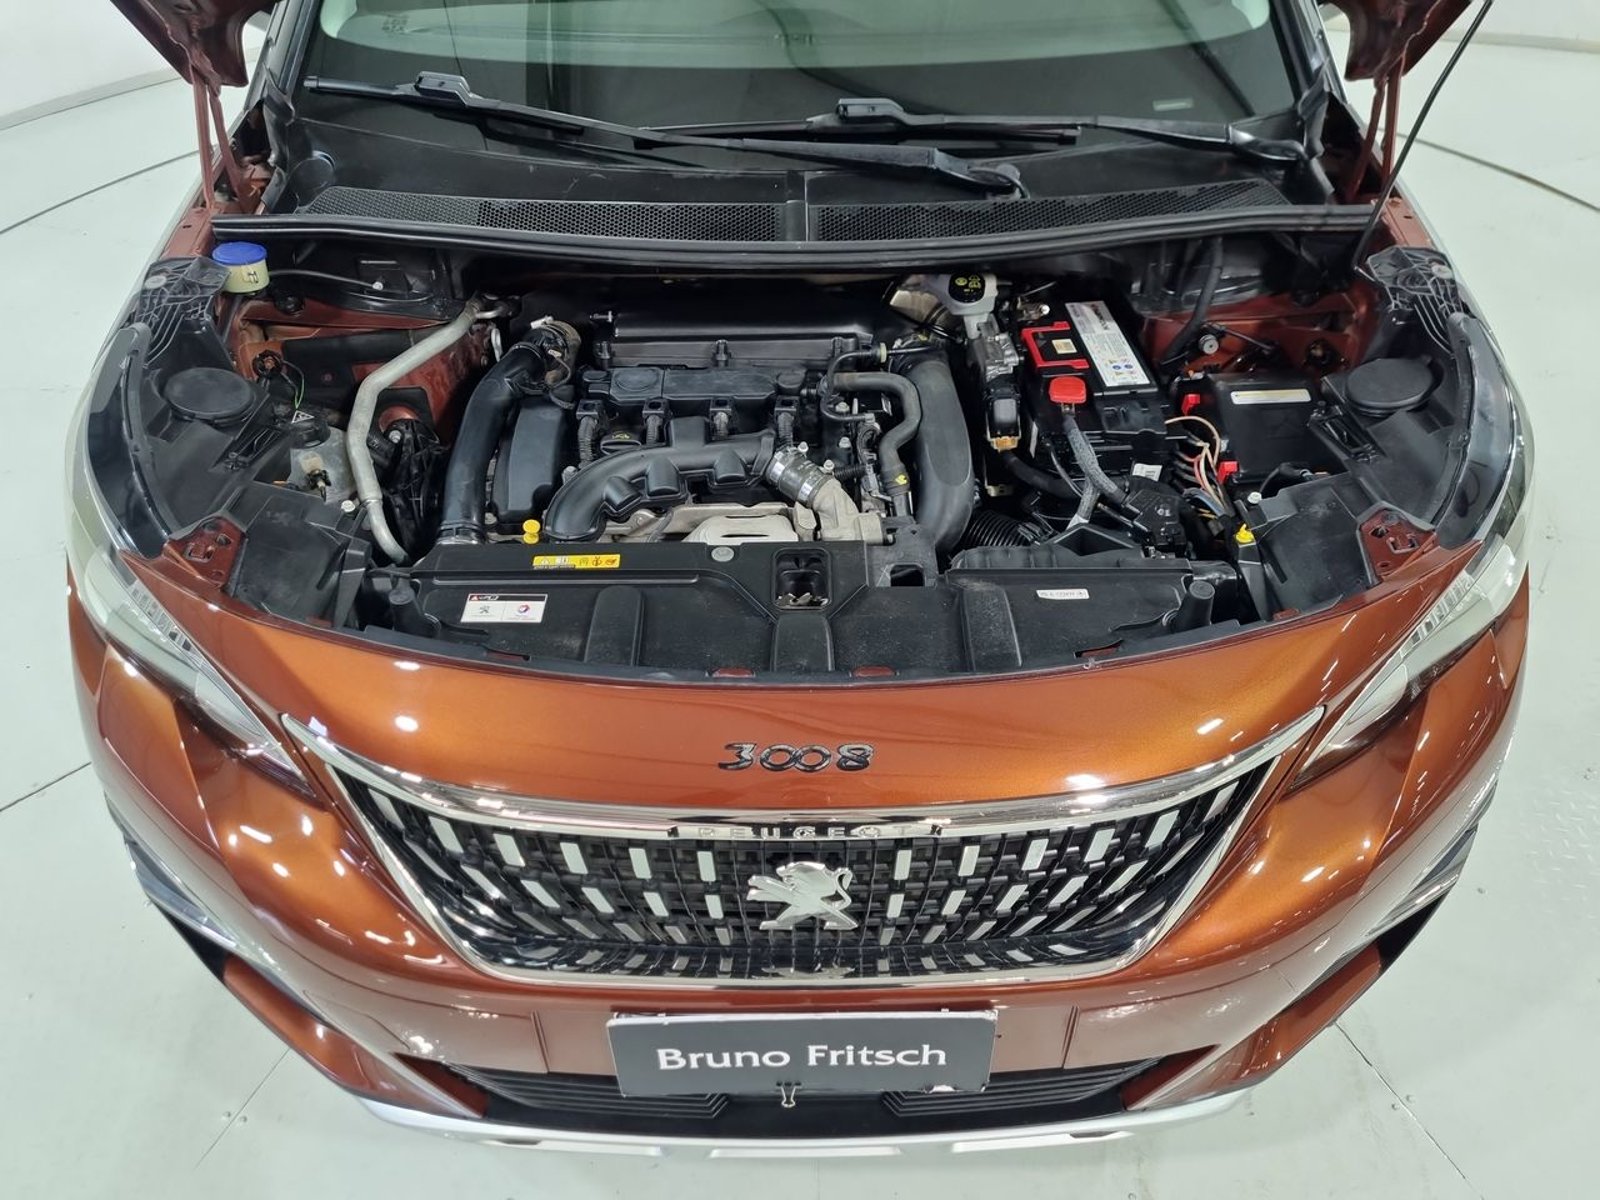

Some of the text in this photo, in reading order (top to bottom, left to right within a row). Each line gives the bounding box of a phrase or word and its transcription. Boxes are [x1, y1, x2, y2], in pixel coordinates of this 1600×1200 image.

[718, 743, 875, 772] 3008
[699, 825, 912, 840] PEUGEOT
[656, 1044, 947, 1070] Bruno Fritsch
